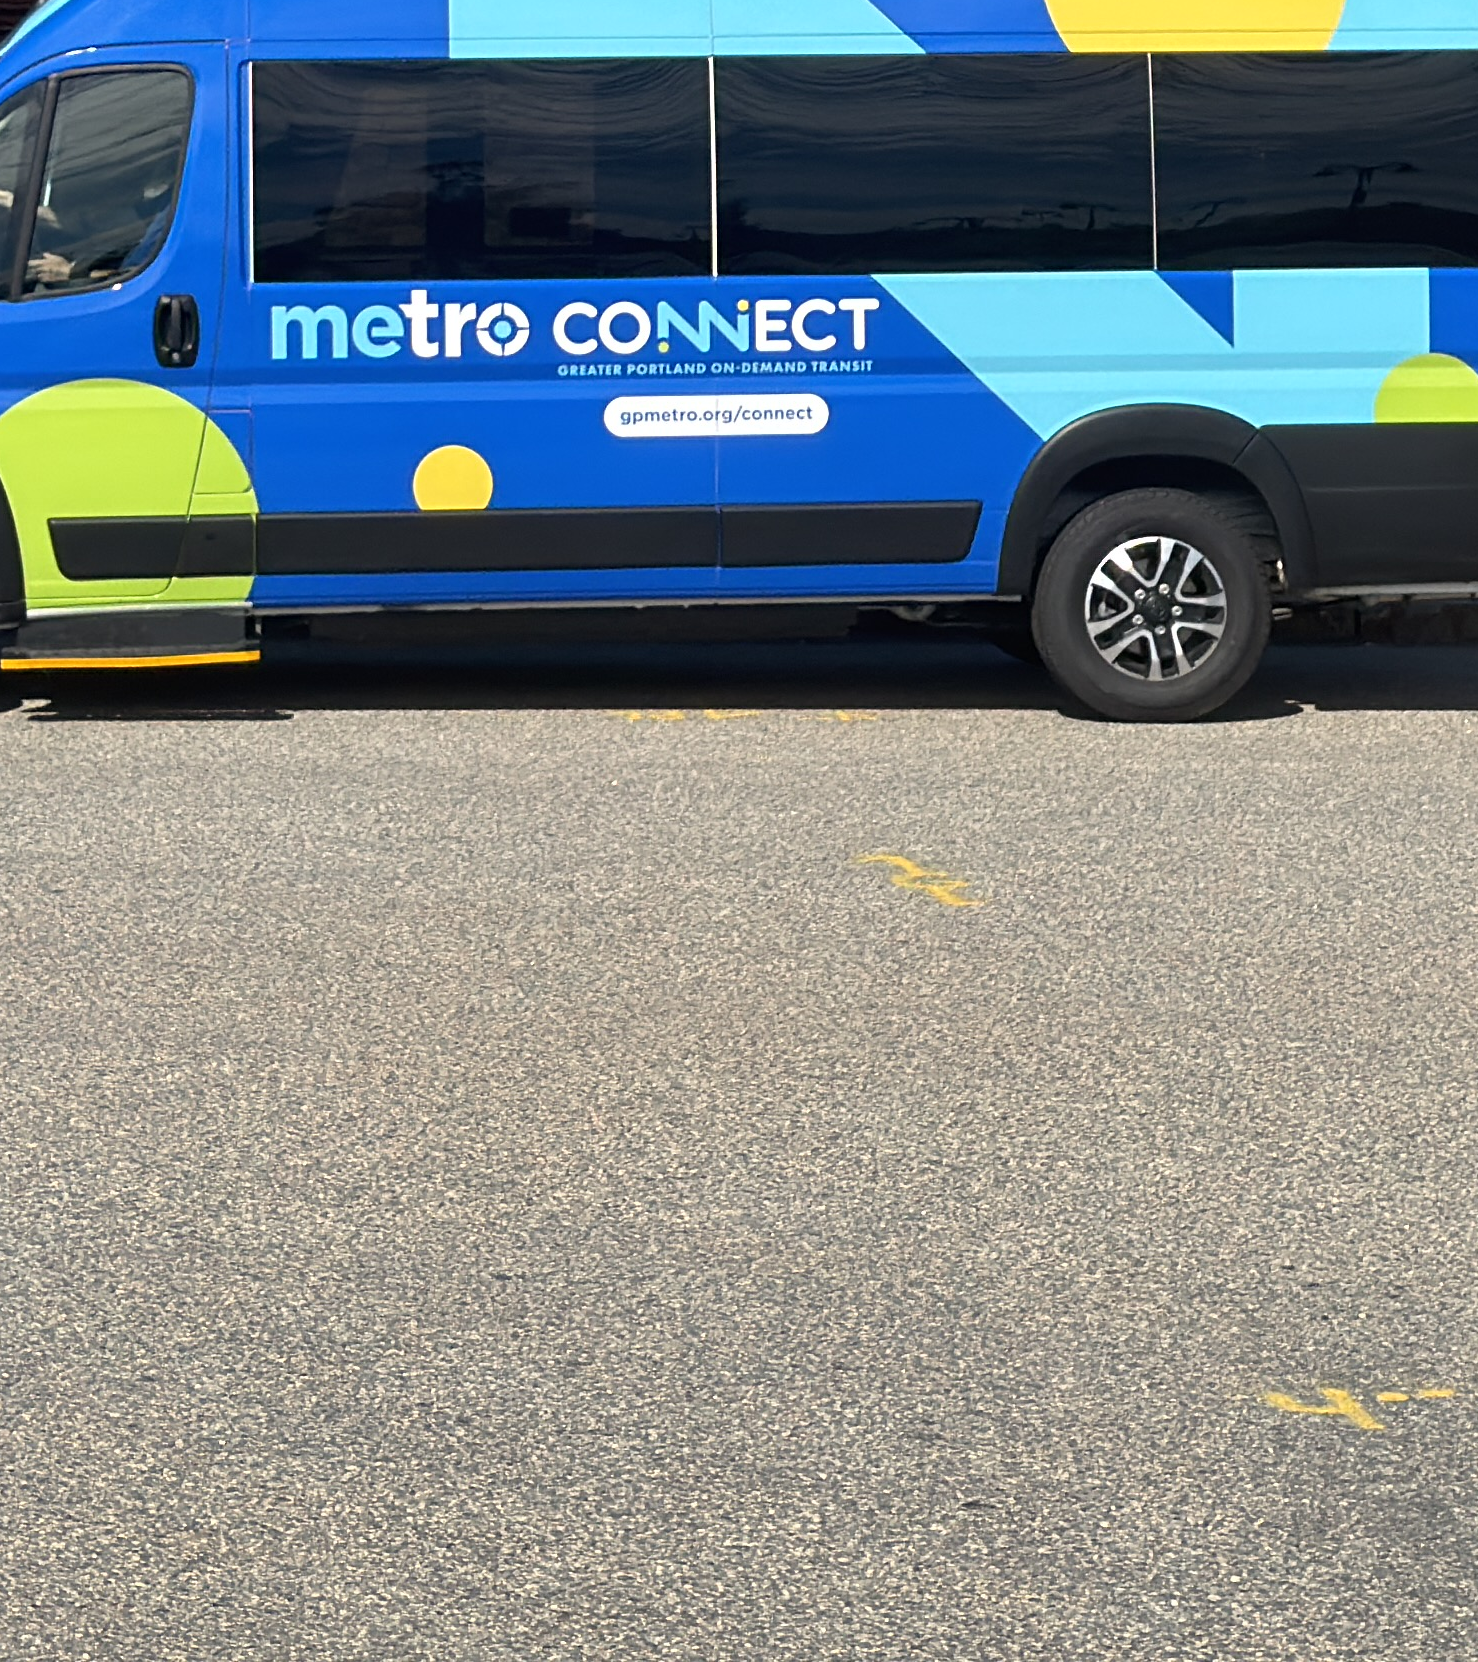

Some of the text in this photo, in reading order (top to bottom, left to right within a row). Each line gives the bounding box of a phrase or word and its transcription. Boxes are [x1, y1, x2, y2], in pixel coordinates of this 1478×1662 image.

[271, 289, 880, 359] metro CONNECT
[557, 360, 874, 377] GREATER PORTLAND ON-DEMAND TRANSIT
[619, 405, 814, 426] gpmetro.org/connect
